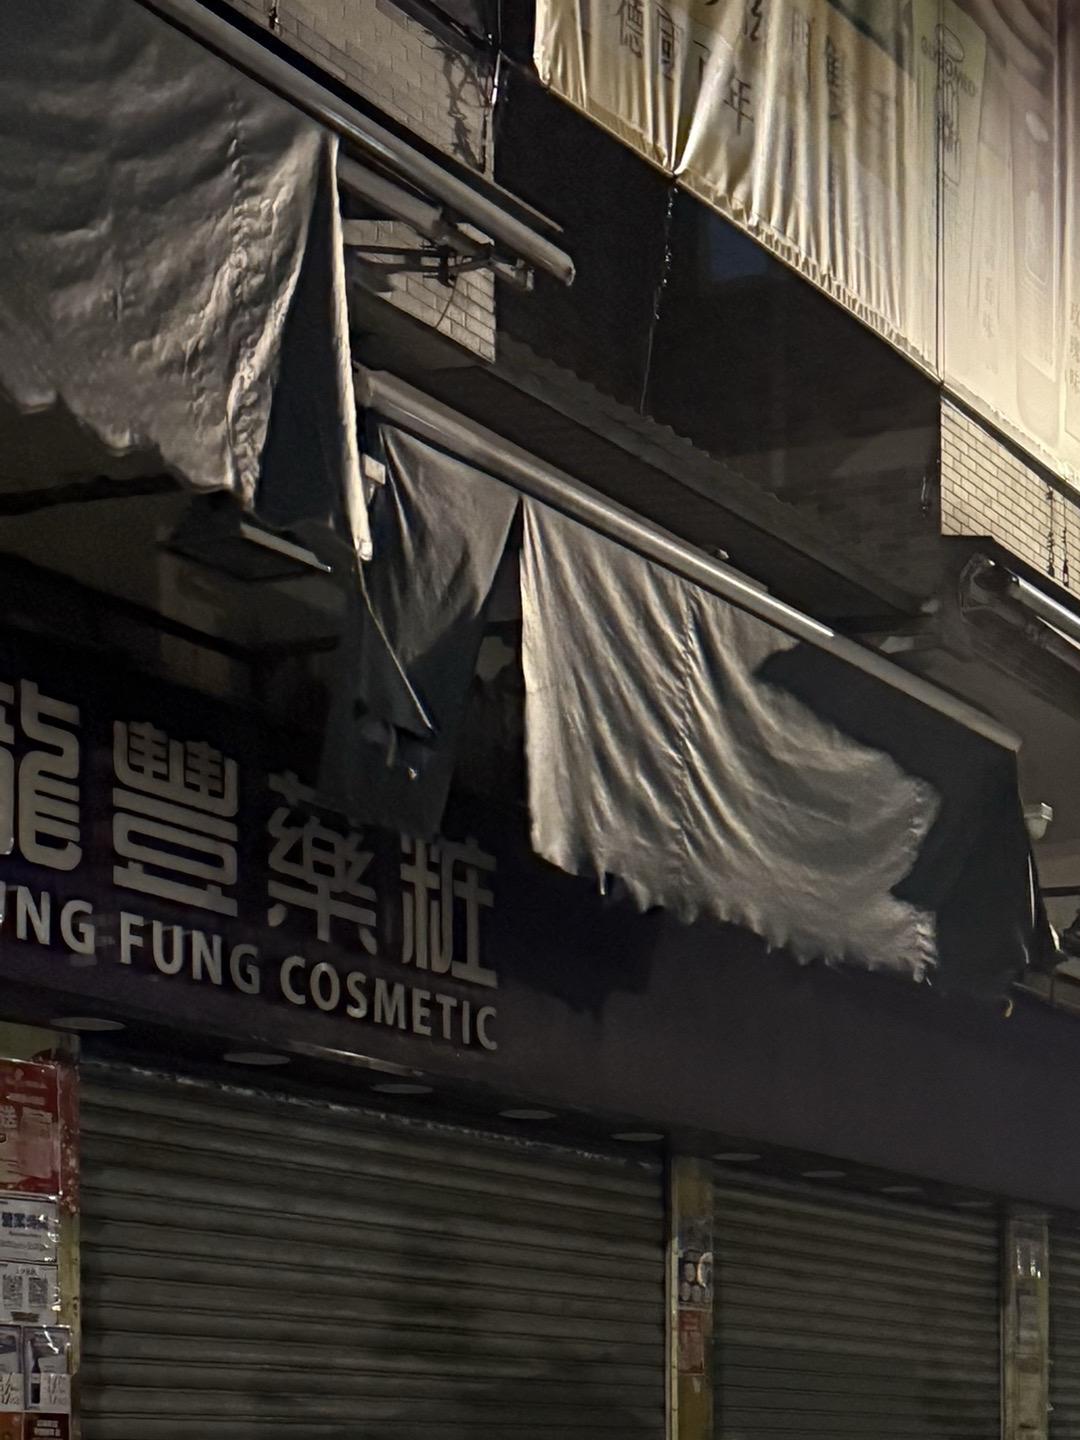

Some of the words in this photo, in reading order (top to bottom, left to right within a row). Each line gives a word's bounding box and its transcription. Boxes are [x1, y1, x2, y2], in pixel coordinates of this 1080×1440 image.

[0, 880, 95, 955] NG
[119, 911, 260, 995] FUNG
[280, 955, 498, 1051] COSMETIC
